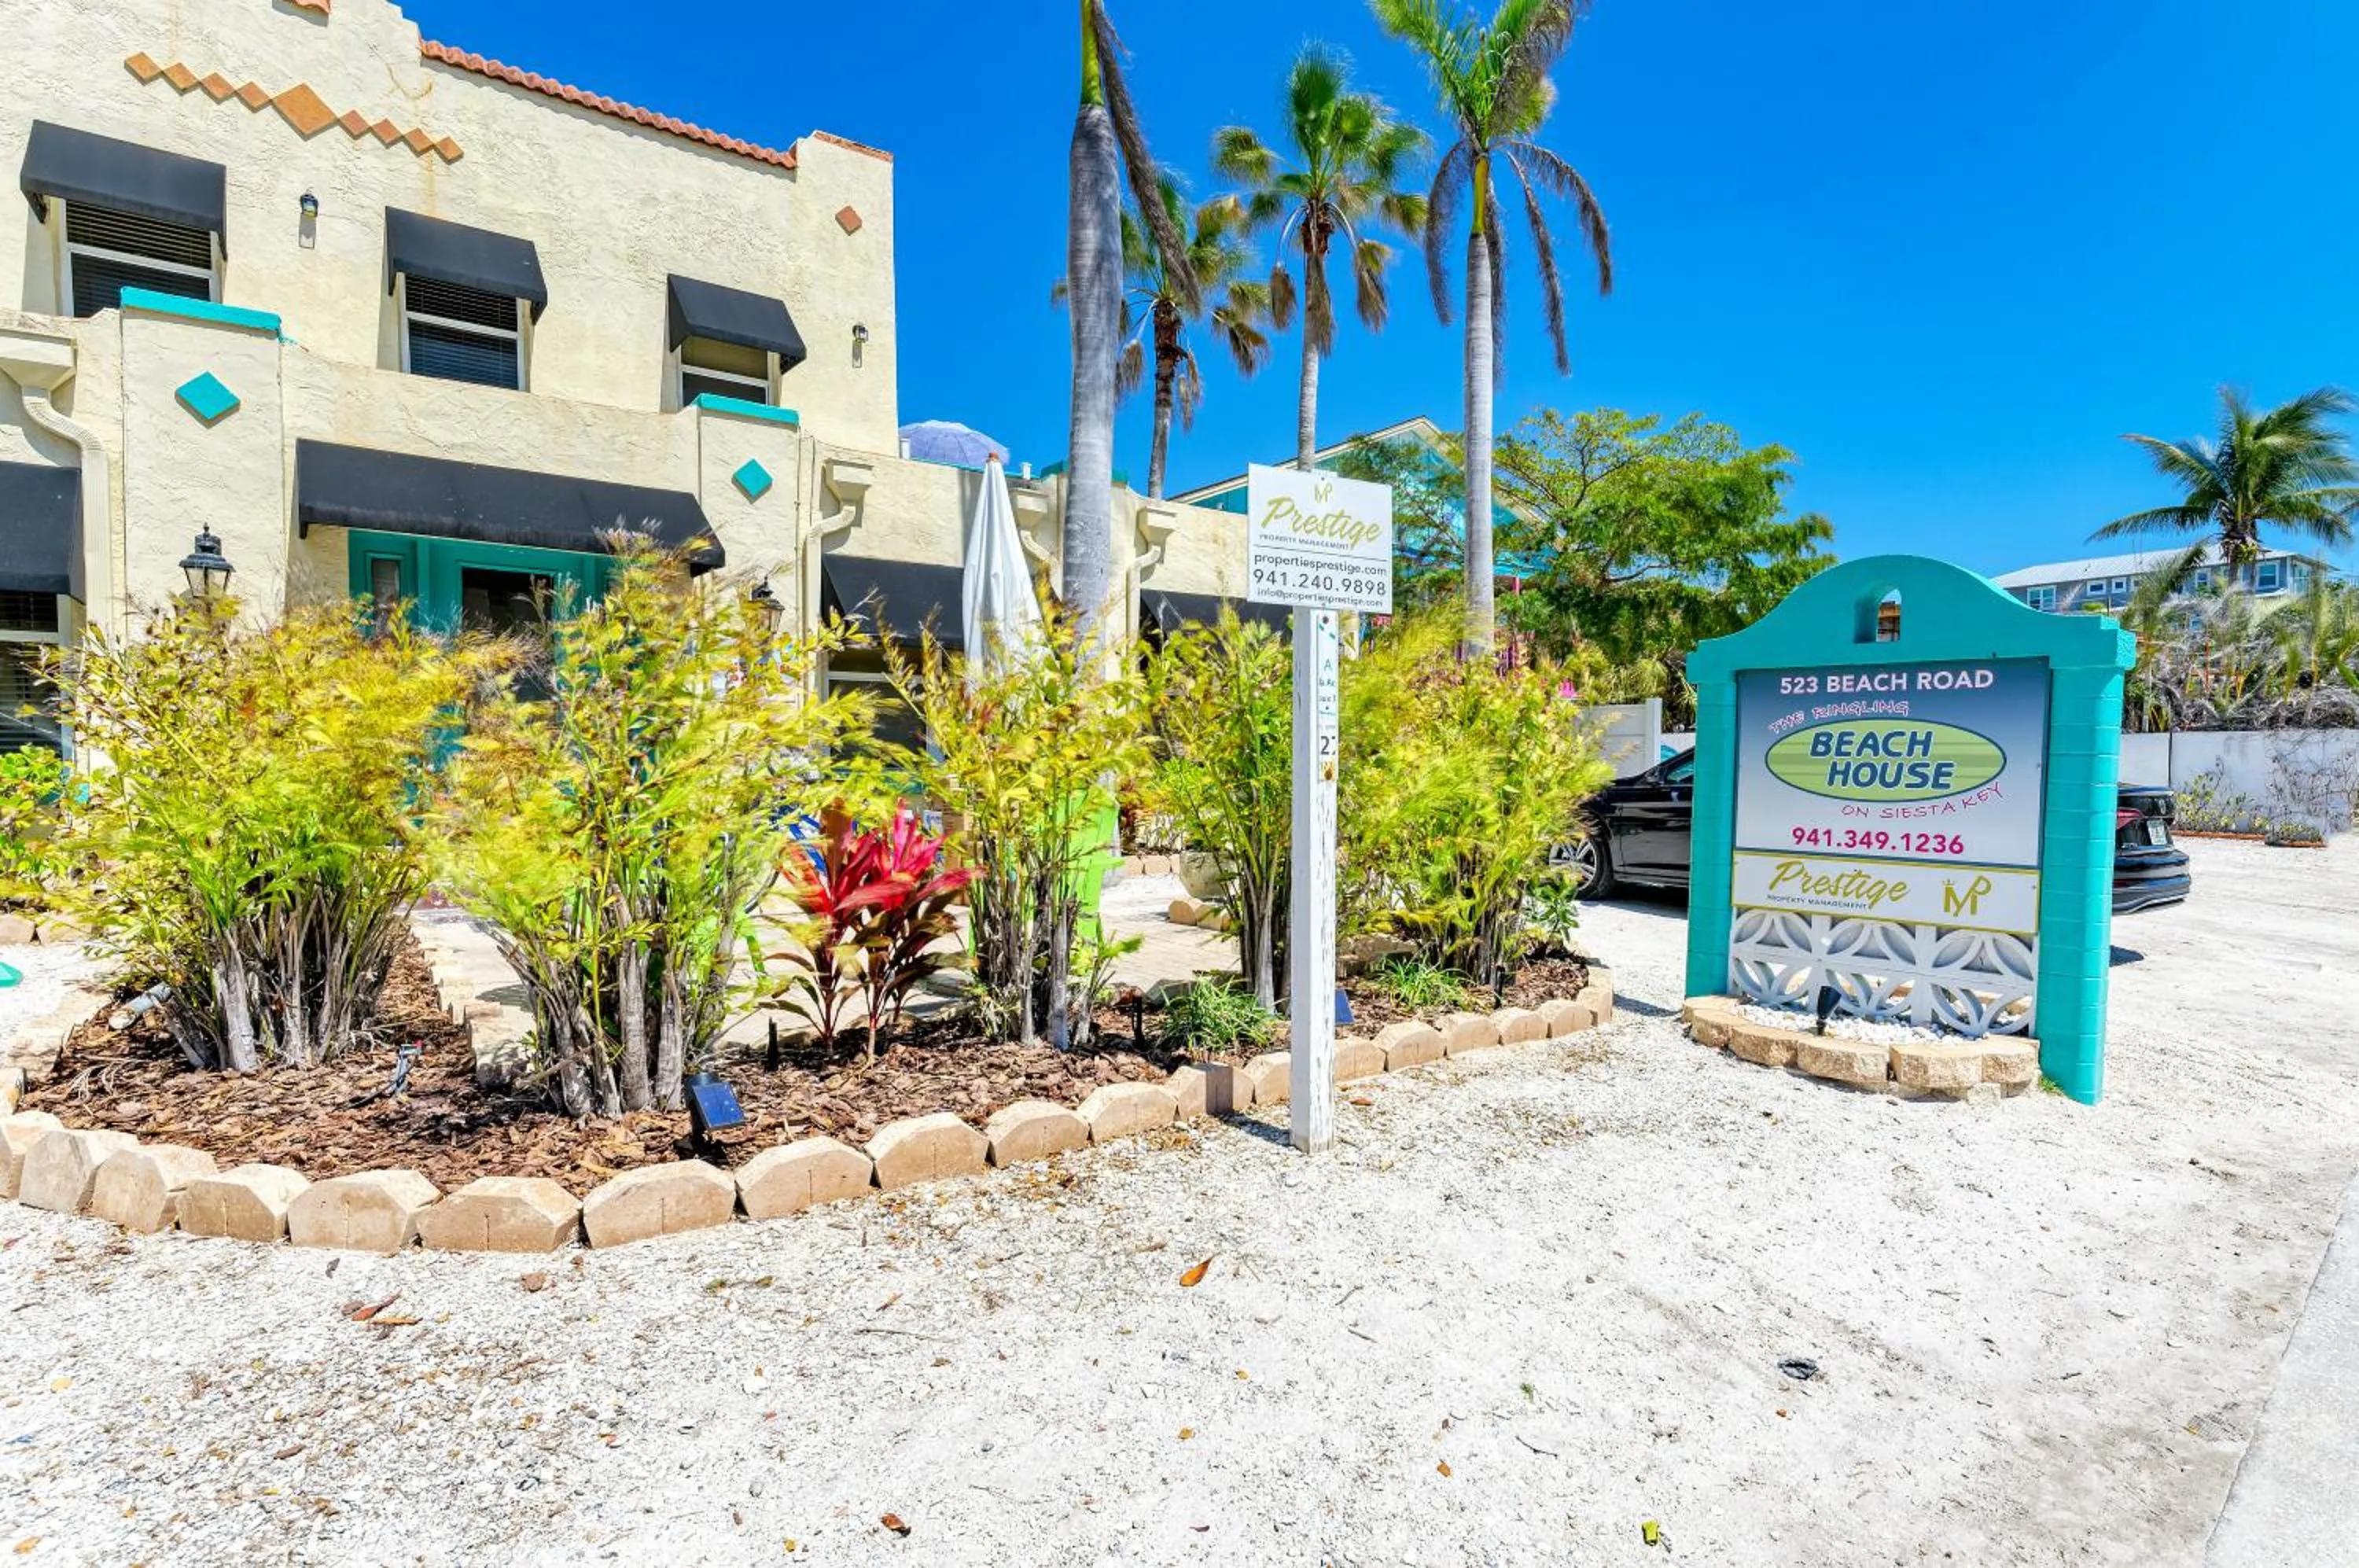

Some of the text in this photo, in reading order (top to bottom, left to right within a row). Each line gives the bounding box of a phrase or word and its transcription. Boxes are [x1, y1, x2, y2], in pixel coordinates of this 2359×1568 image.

[1260, 496, 1382, 550] Prestige
[1259, 534, 1296, 543] PROPERTY
[1254, 554, 1387, 576] propertiesprestige.com
[1253, 569, 1386, 596] 941.240.9898
[1257, 588, 1383, 608] info@propertiesprestige.com
[1779, 669, 1994, 694] 523 BEACH ROAD
[1768, 701, 1910, 734] THE RINGLING
[1810, 731, 1934, 758] BEACH
[1827, 760, 1955, 790] HOUSE
[1842, 782, 2004, 819] ON SIESTA KEY
[1791, 826, 1964, 855] 941.349.1236
[1768, 859, 1911, 910] Prestige
[1767, 895, 1867, 910] PROPERTY MANAGEMENT
